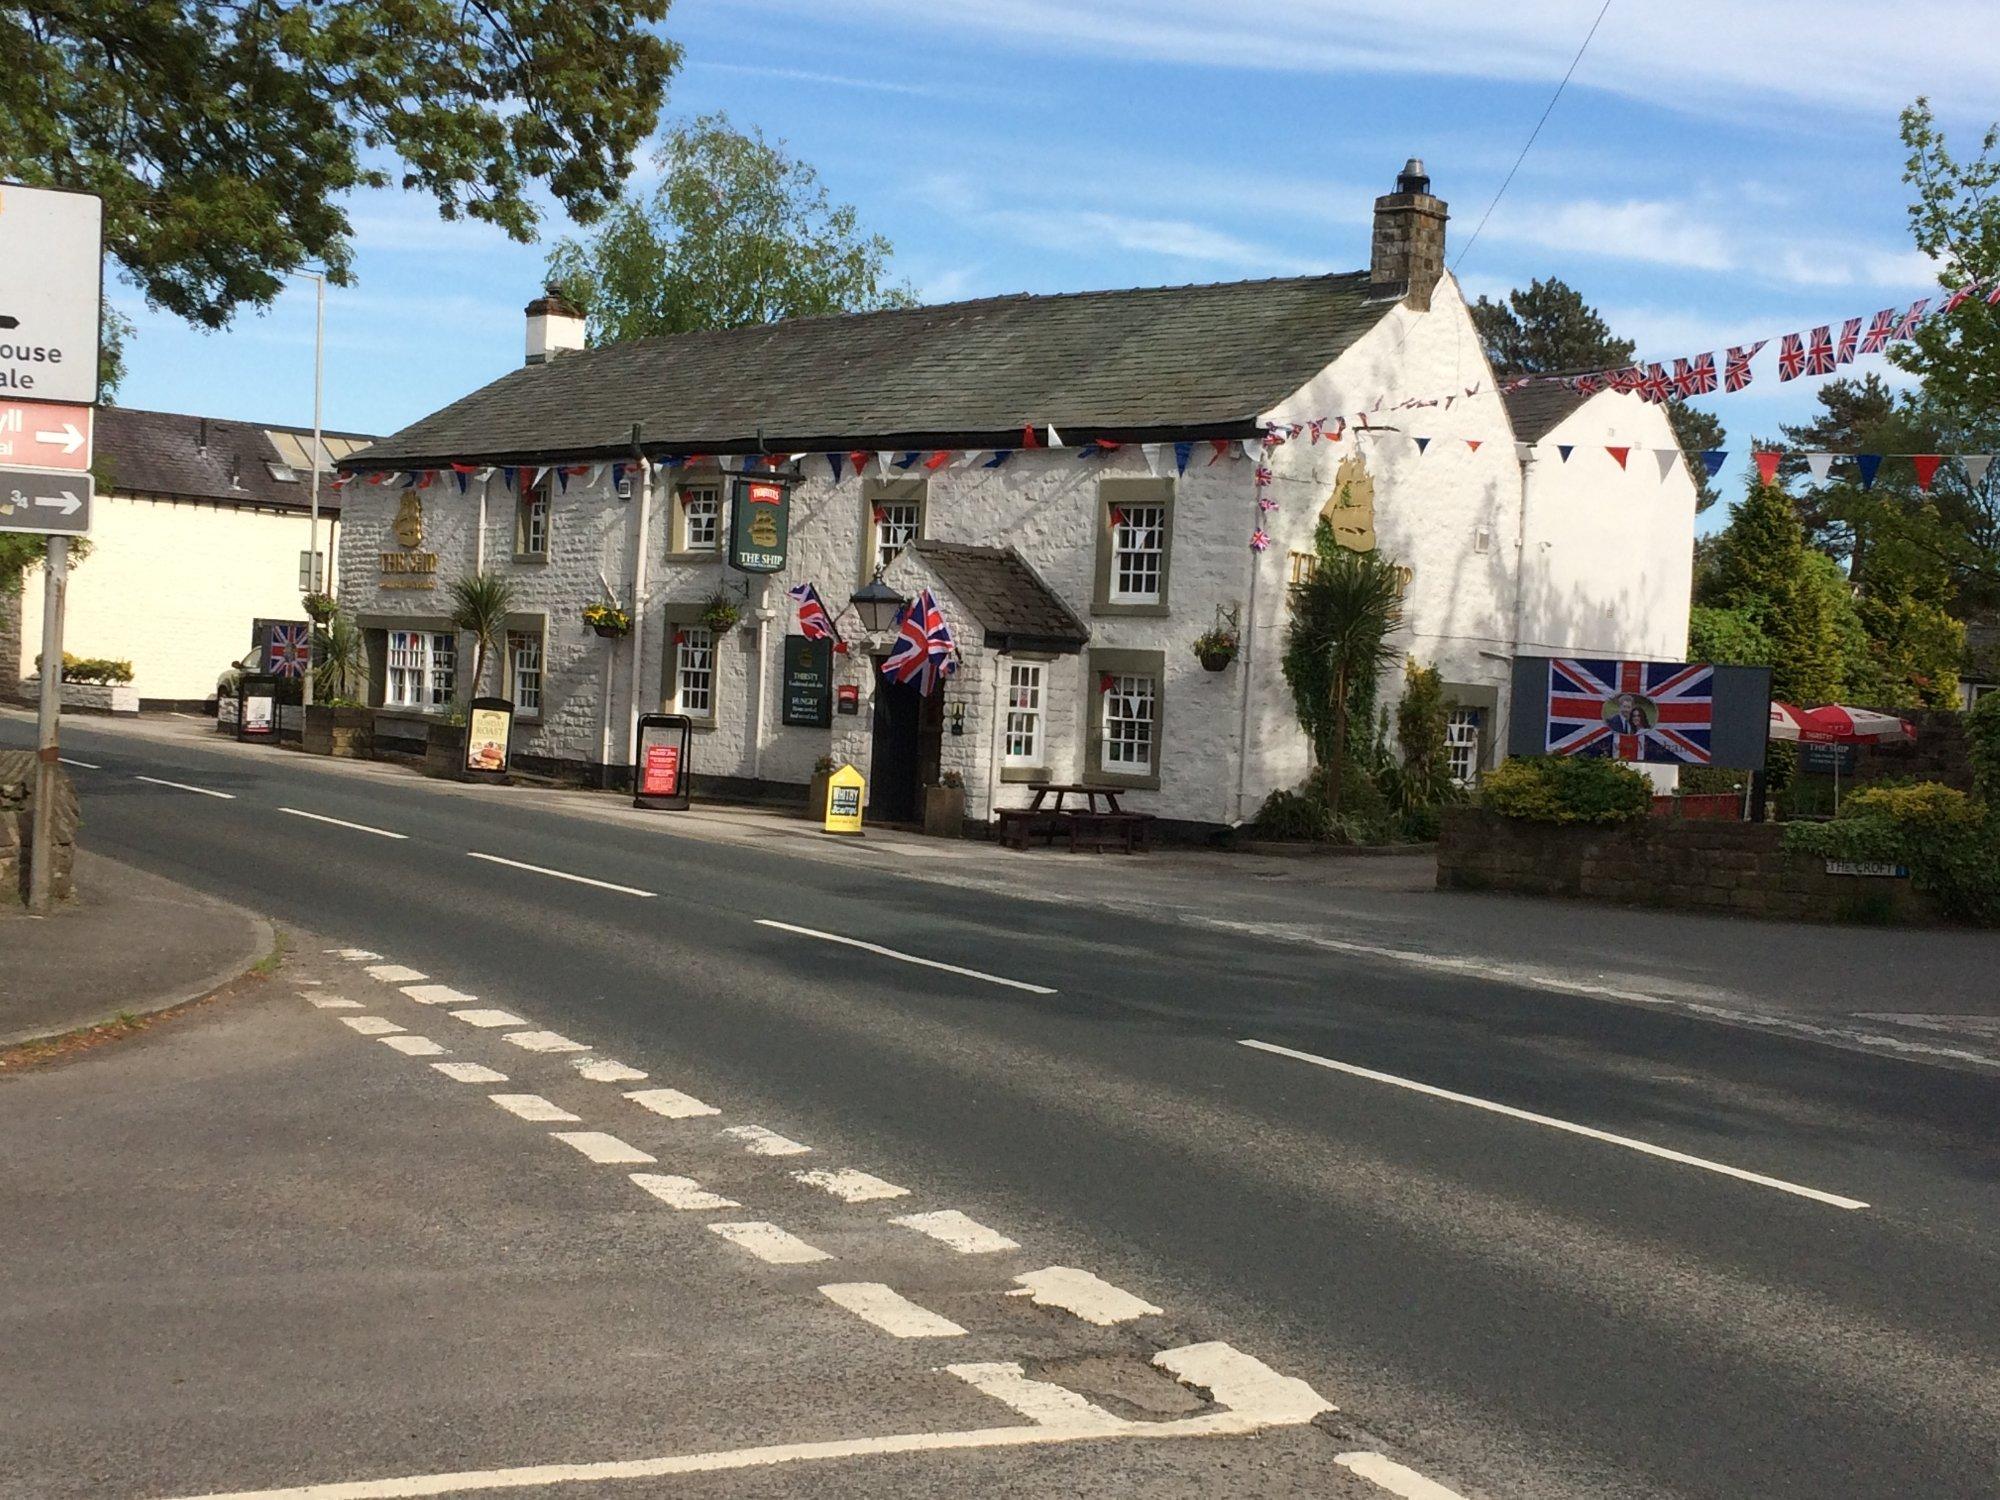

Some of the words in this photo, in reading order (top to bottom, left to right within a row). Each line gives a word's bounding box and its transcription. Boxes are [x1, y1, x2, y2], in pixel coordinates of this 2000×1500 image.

[380, 553, 404, 572] THE
[739, 551, 760, 563] THE
[761, 554, 783, 565] SHIP
